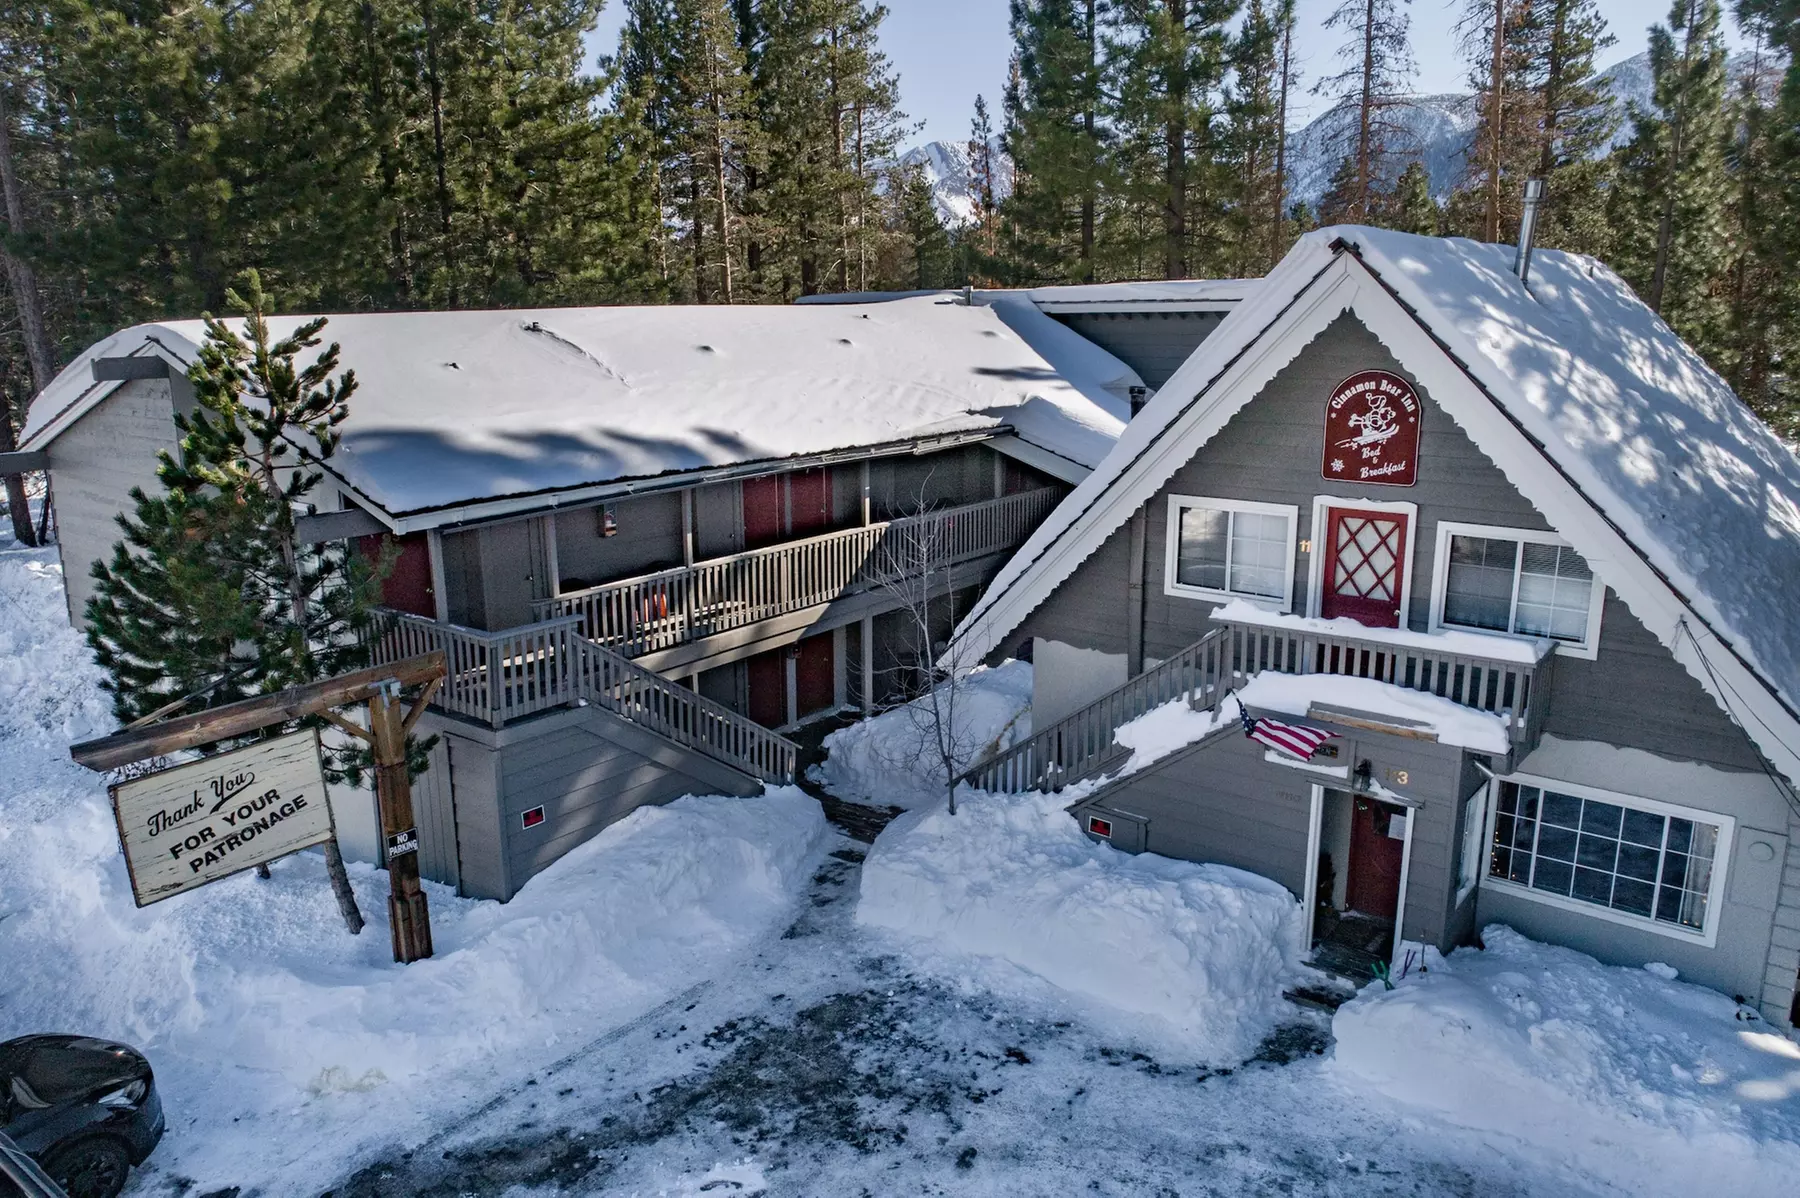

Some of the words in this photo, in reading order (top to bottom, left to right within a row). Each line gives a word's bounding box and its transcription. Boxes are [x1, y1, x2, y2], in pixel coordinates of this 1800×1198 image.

[1331, 381, 1376, 409] Cinnamon
[1379, 379, 1403, 396] Bear
[1400, 392, 1416, 413] Inn
[1361, 446, 1381, 459] Bed
[1360, 461, 1406, 479] Breakfast
[147, 790, 204, 837] Thank
[208, 771, 255, 815] You
[169, 826, 216, 860] FOR
[222, 788, 281, 827] YOUR
[189, 794, 308, 873] PATRONAGE
[389, 839, 418, 856] PARKING
[397, 833, 408, 844] NO
